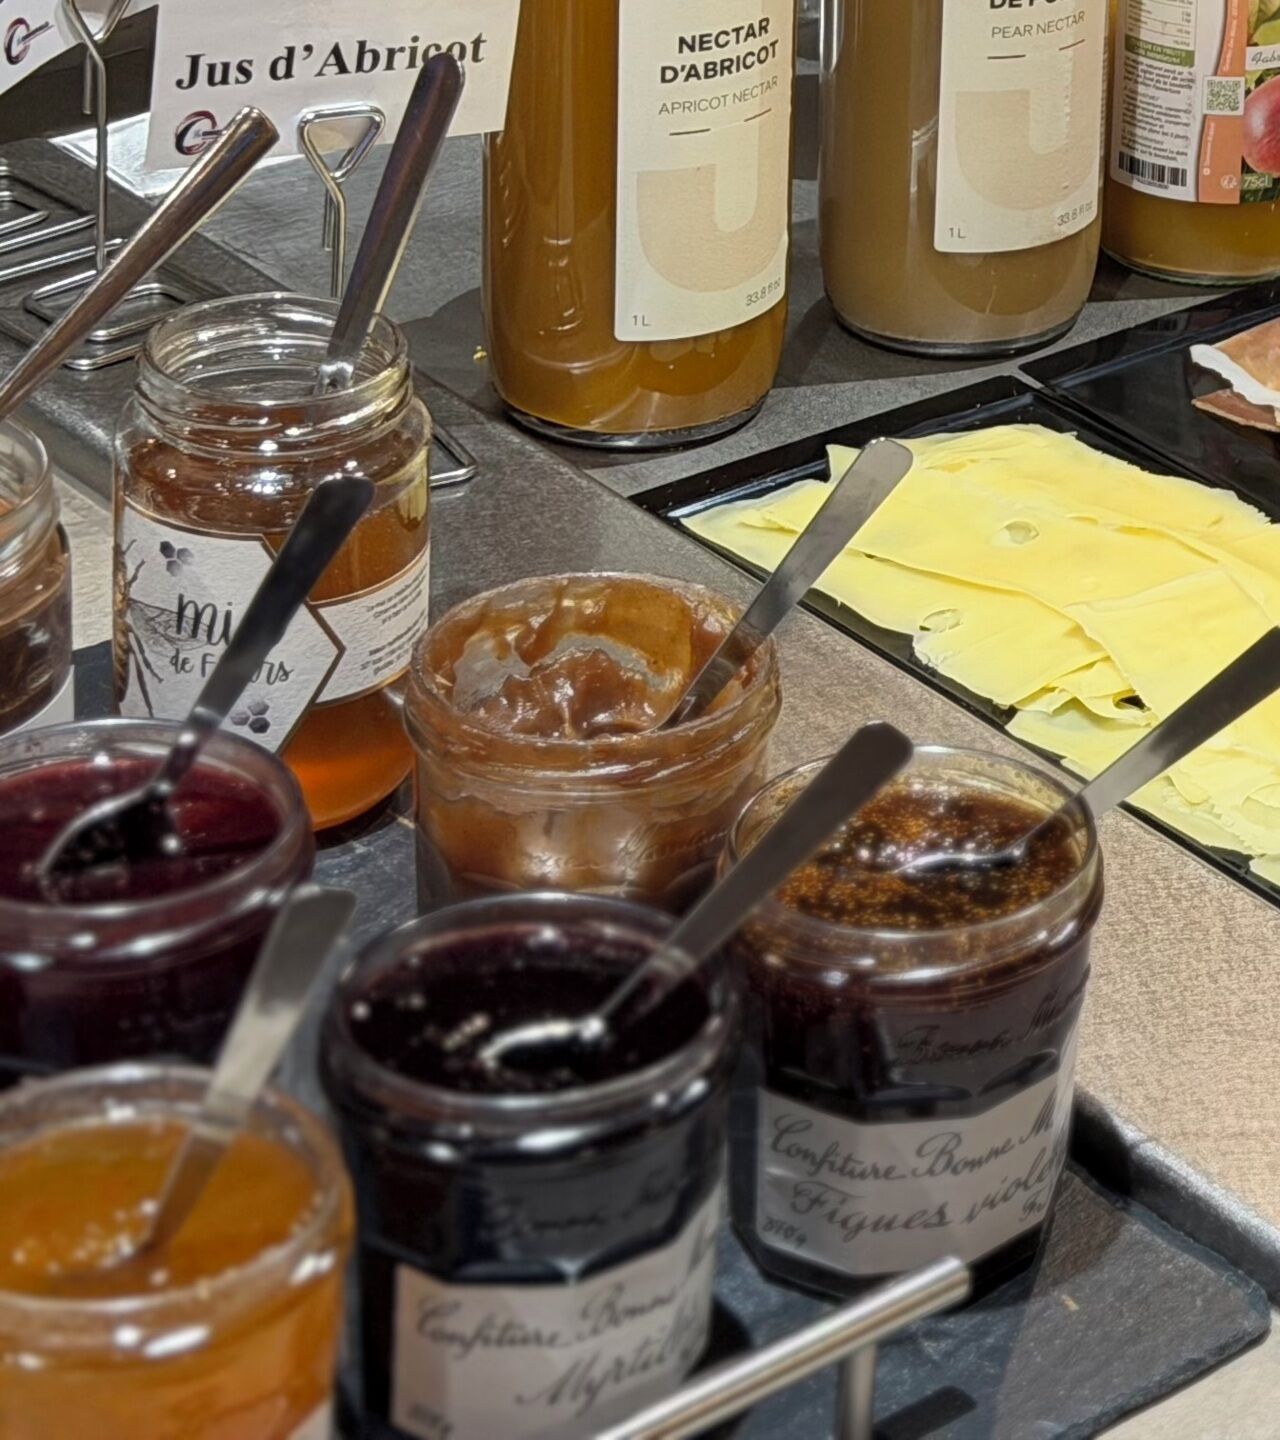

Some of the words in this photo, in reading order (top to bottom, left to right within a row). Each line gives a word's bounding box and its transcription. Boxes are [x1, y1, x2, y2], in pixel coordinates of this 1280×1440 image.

[678, 16, 771, 55] NECTAR
[991, 23, 1033, 39] PEAR
[1036, 11, 1086, 35] NECTAR
[175, 52, 254, 90] Jus
[660, 39, 779, 85] D'ABRICOT
[658, 95, 729, 116] APRICOT
[732, 75, 779, 106] NECTAR
[1244, 175, 1270, 189] 75cl
[769, 1114, 905, 1181] Confiture
[911, 1132, 1015, 1177] Bonne
[790, 1181, 953, 1243] Figues
[417, 1295, 562, 1360] Confiture
